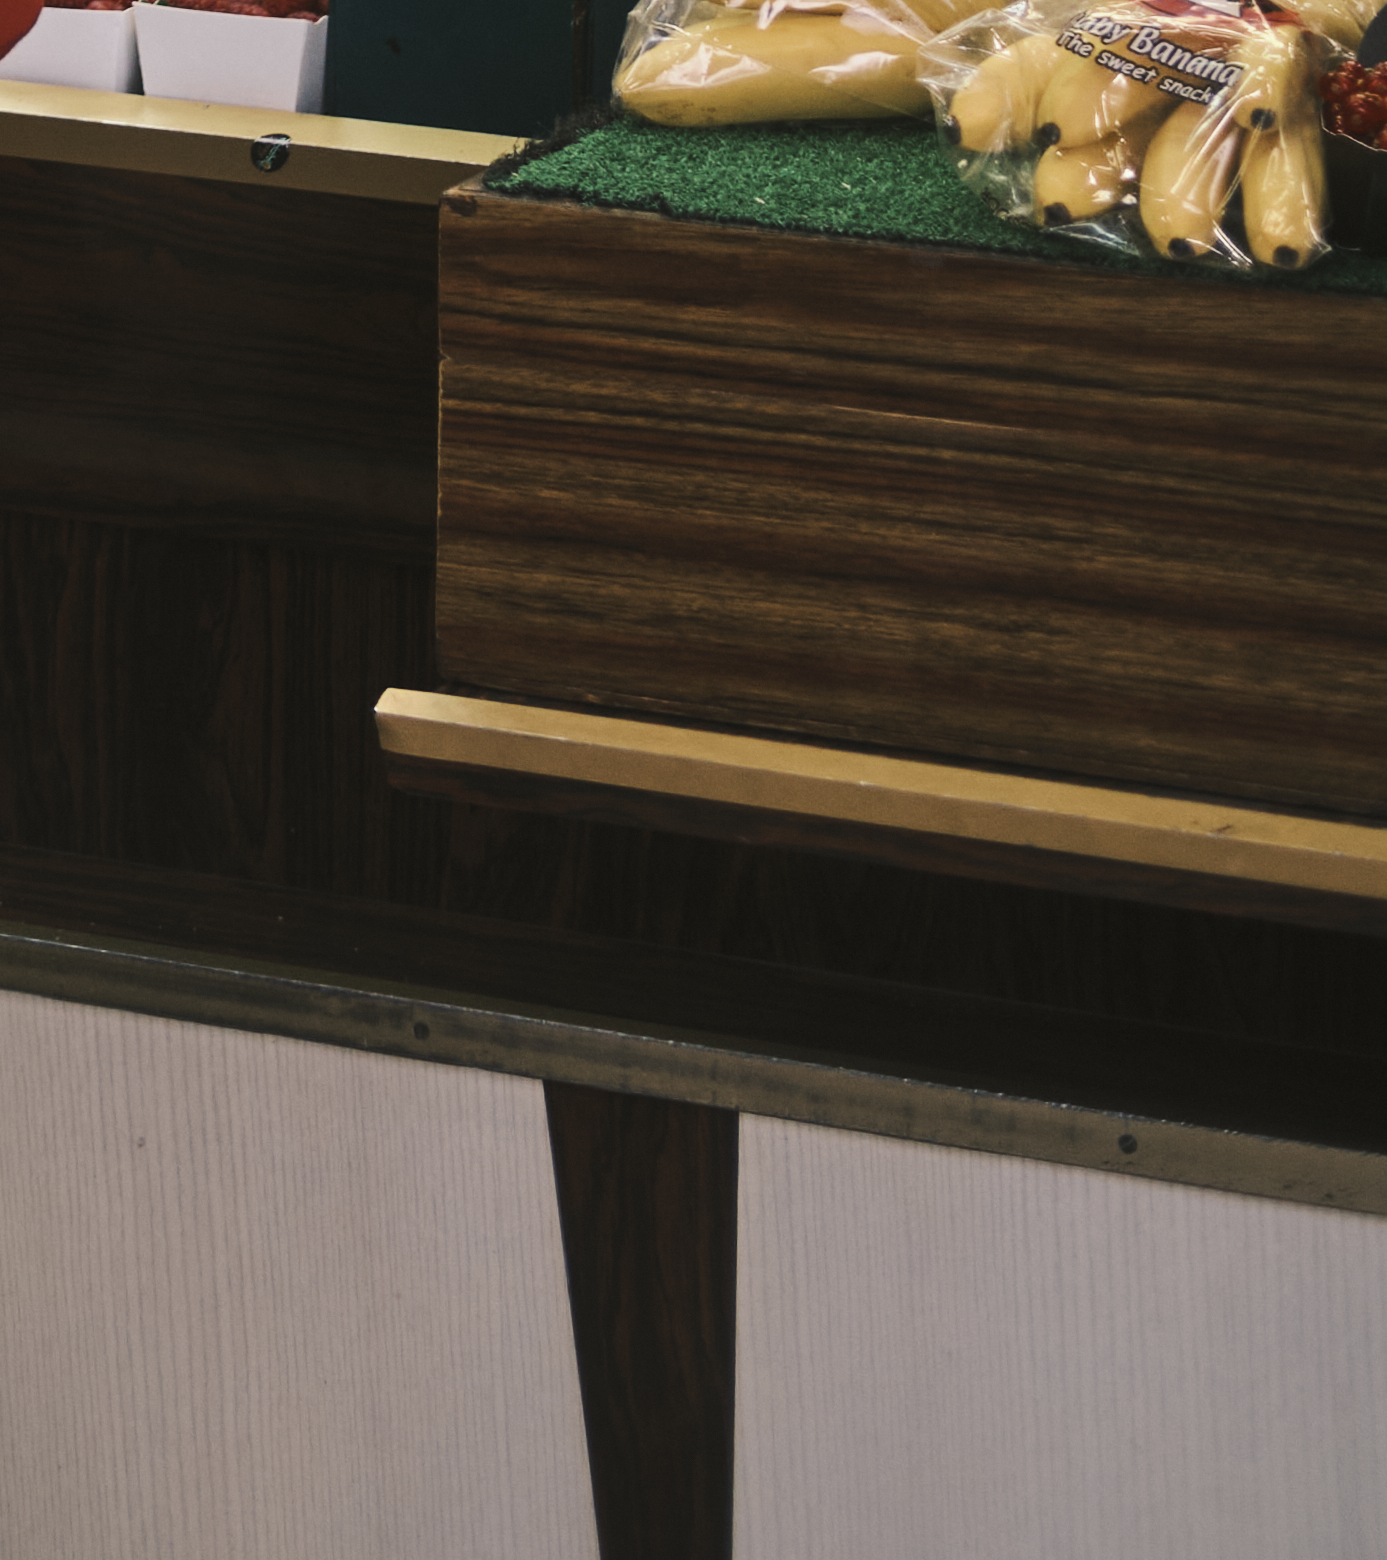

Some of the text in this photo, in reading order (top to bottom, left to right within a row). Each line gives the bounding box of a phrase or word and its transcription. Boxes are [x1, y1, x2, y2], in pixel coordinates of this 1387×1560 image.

[1055, 29, 1219, 106] The sweet snack
[1127, 24, 1248, 88] Banana
